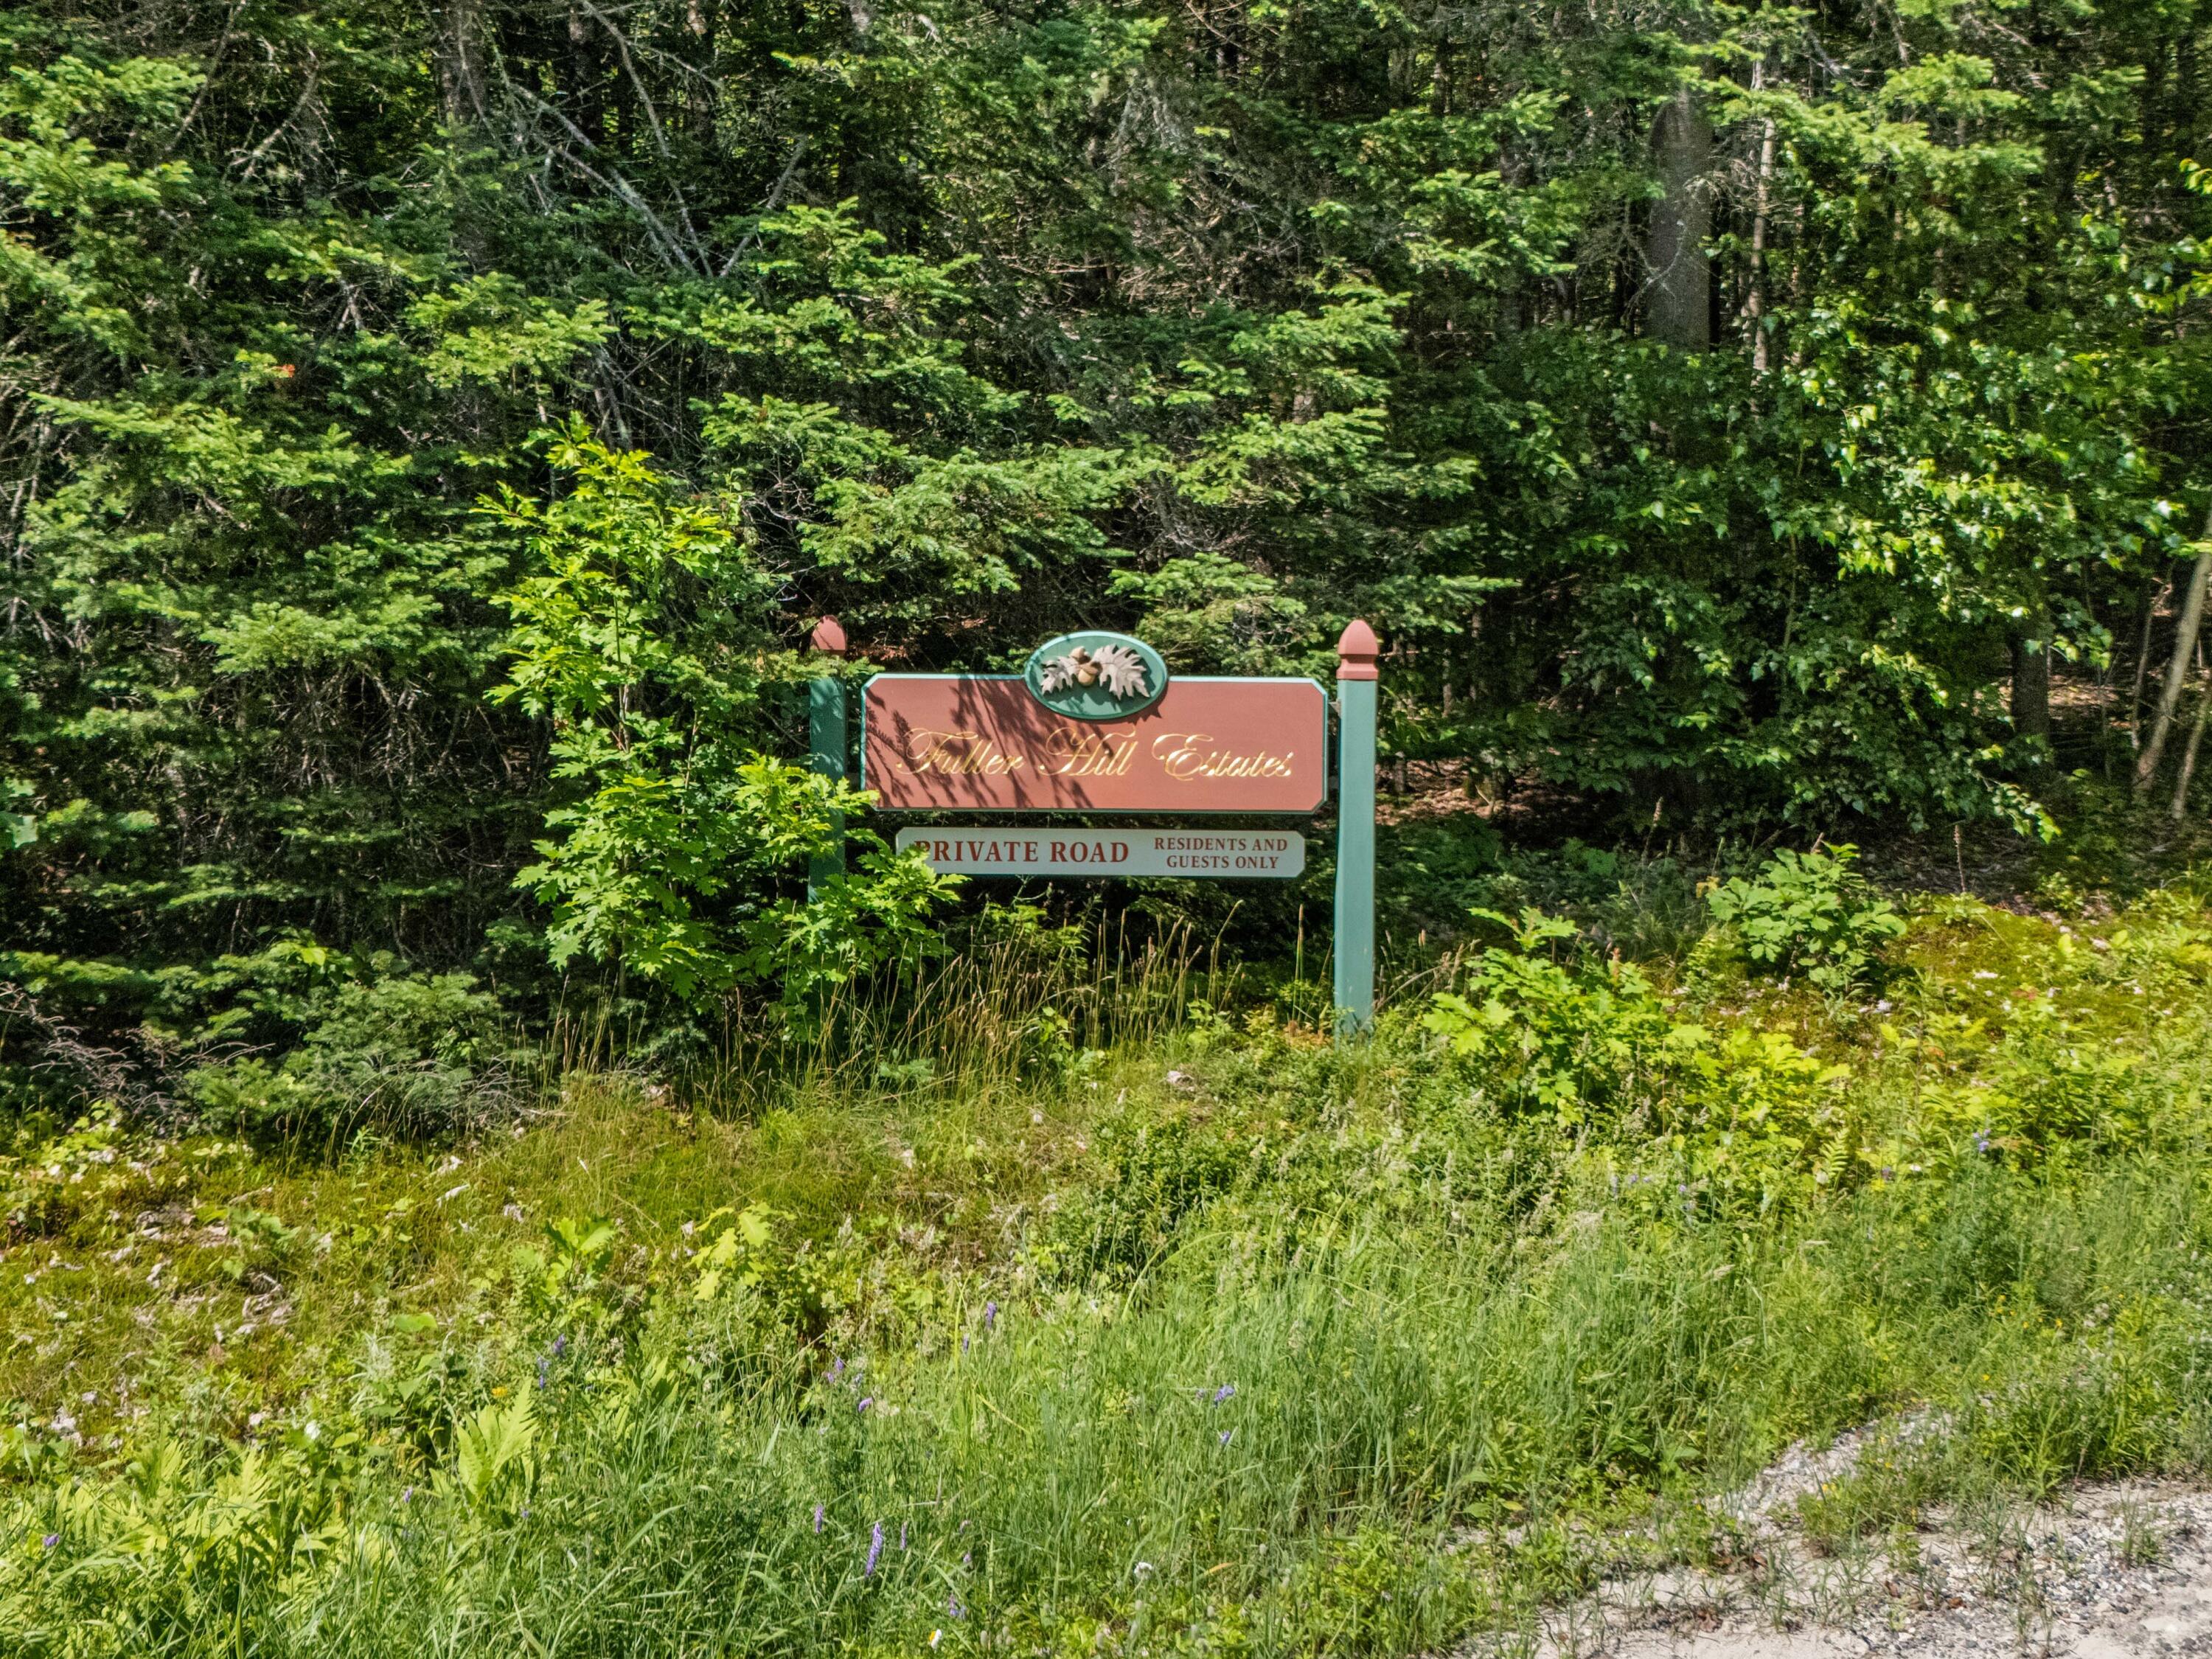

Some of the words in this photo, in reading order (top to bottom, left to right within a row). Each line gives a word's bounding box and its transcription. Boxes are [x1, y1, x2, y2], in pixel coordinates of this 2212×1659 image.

[897, 728, 1024, 775] Fuller
[1038, 725, 1138, 776] Hill
[1152, 734, 1294, 781] Estates
[1050, 841, 1129, 863] ROAD
[1155, 837, 1246, 851] RESIDENTS
[1253, 838, 1287, 852] AND
[1166, 855, 1229, 869] GUESTS
[1236, 856, 1279, 869] ONLY
